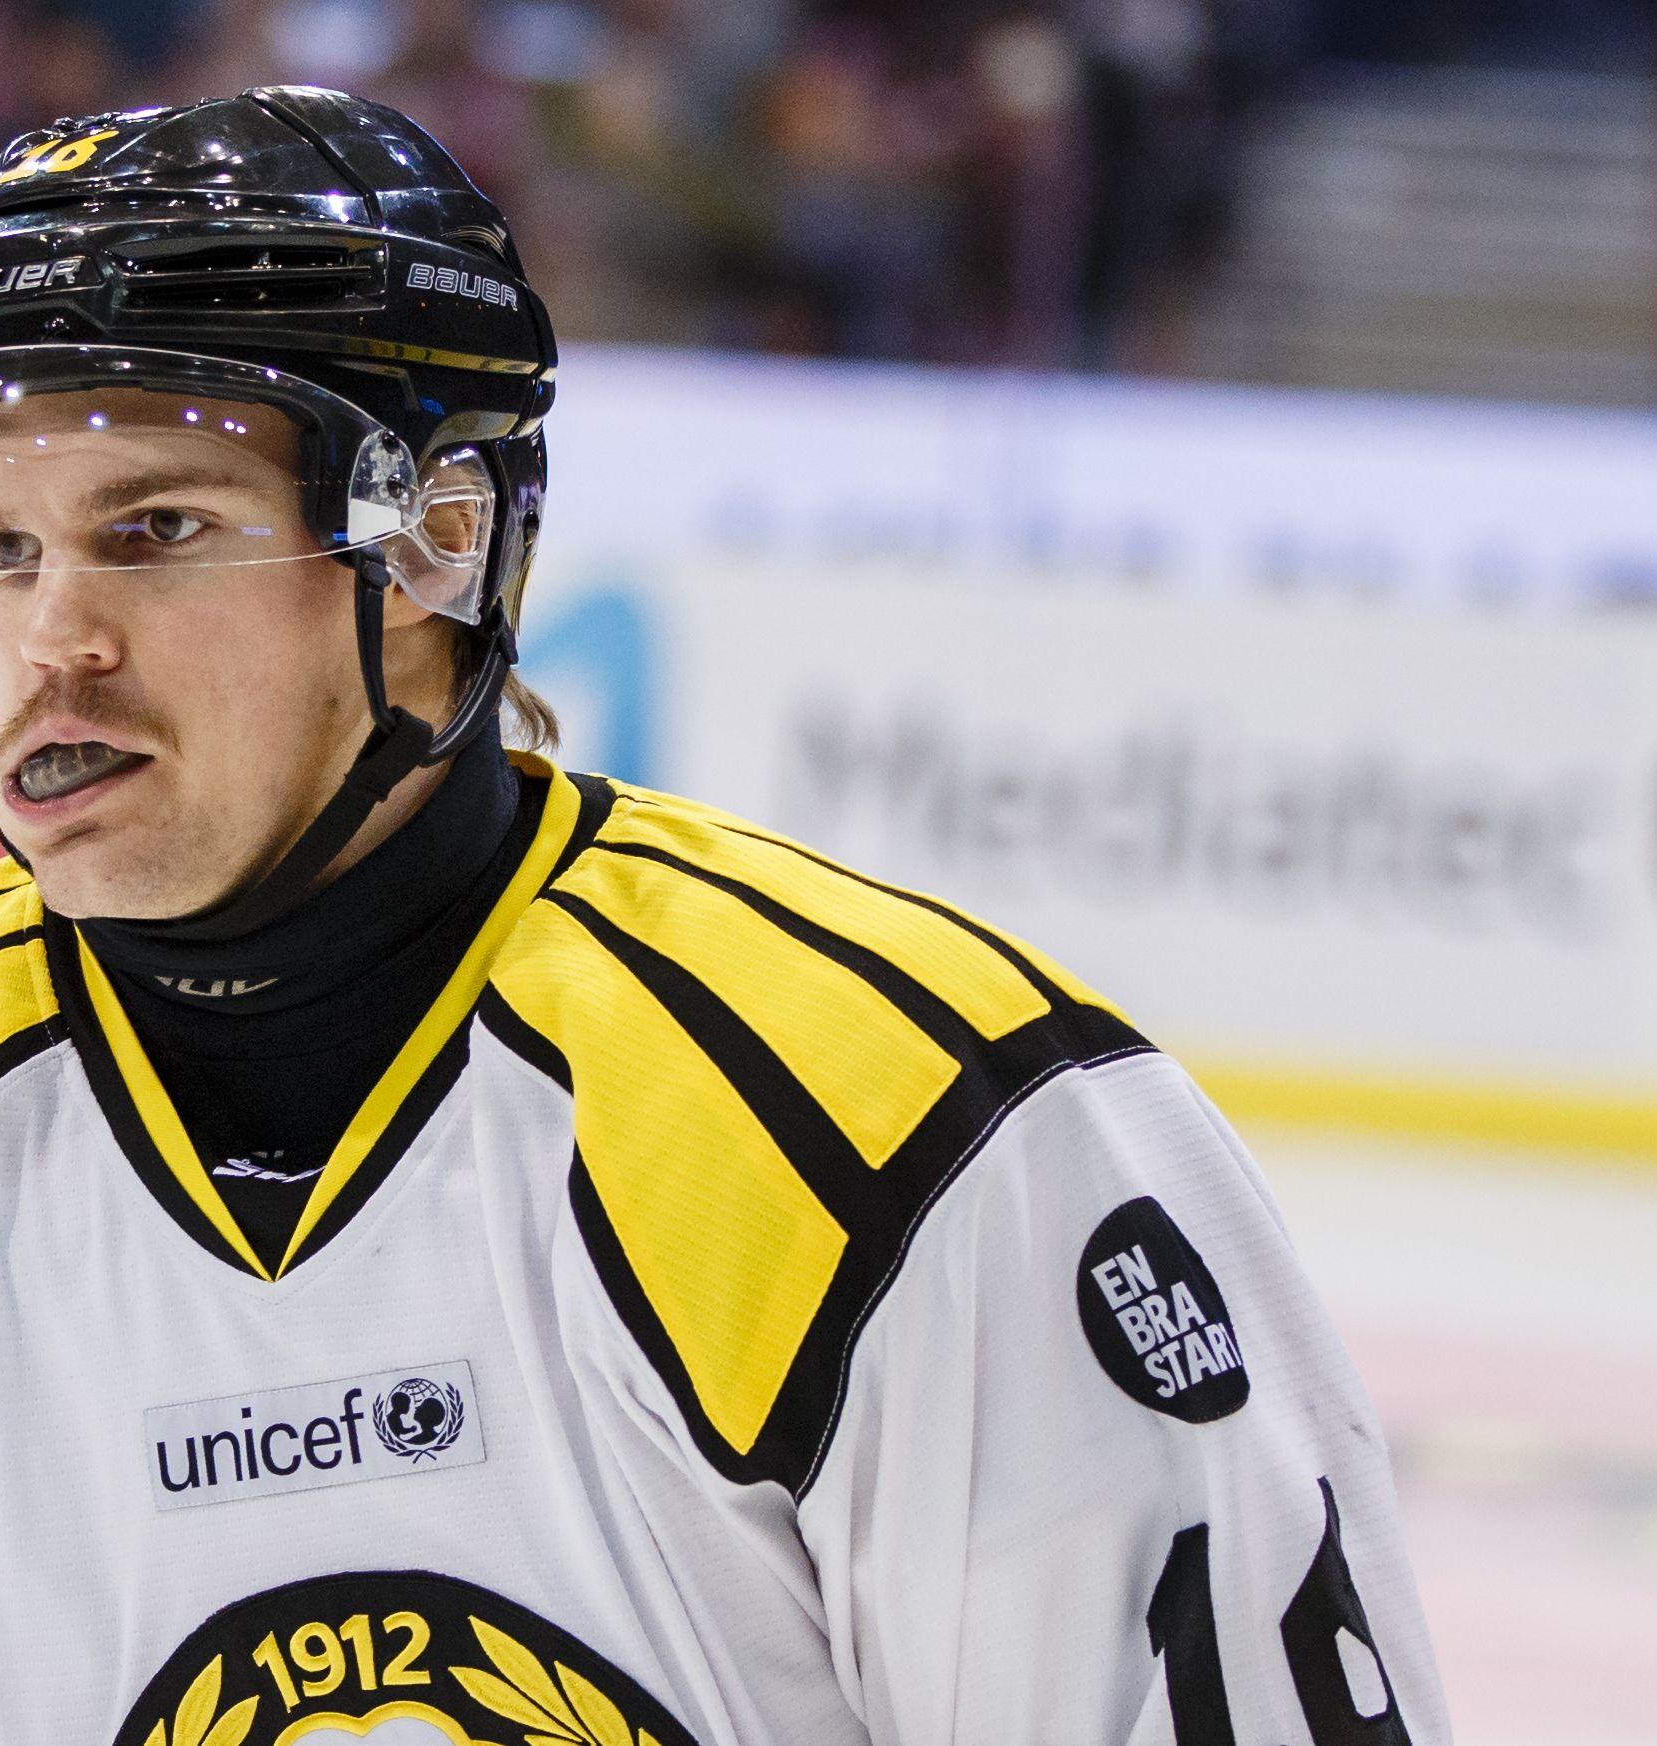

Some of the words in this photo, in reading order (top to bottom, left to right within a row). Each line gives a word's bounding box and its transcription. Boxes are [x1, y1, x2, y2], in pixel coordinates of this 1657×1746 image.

[1090, 1244, 1158, 1310] EN
[1115, 1281, 1207, 1356] BRA
[156, 1388, 365, 1492] unicef
[252, 1611, 432, 1713] 1912
